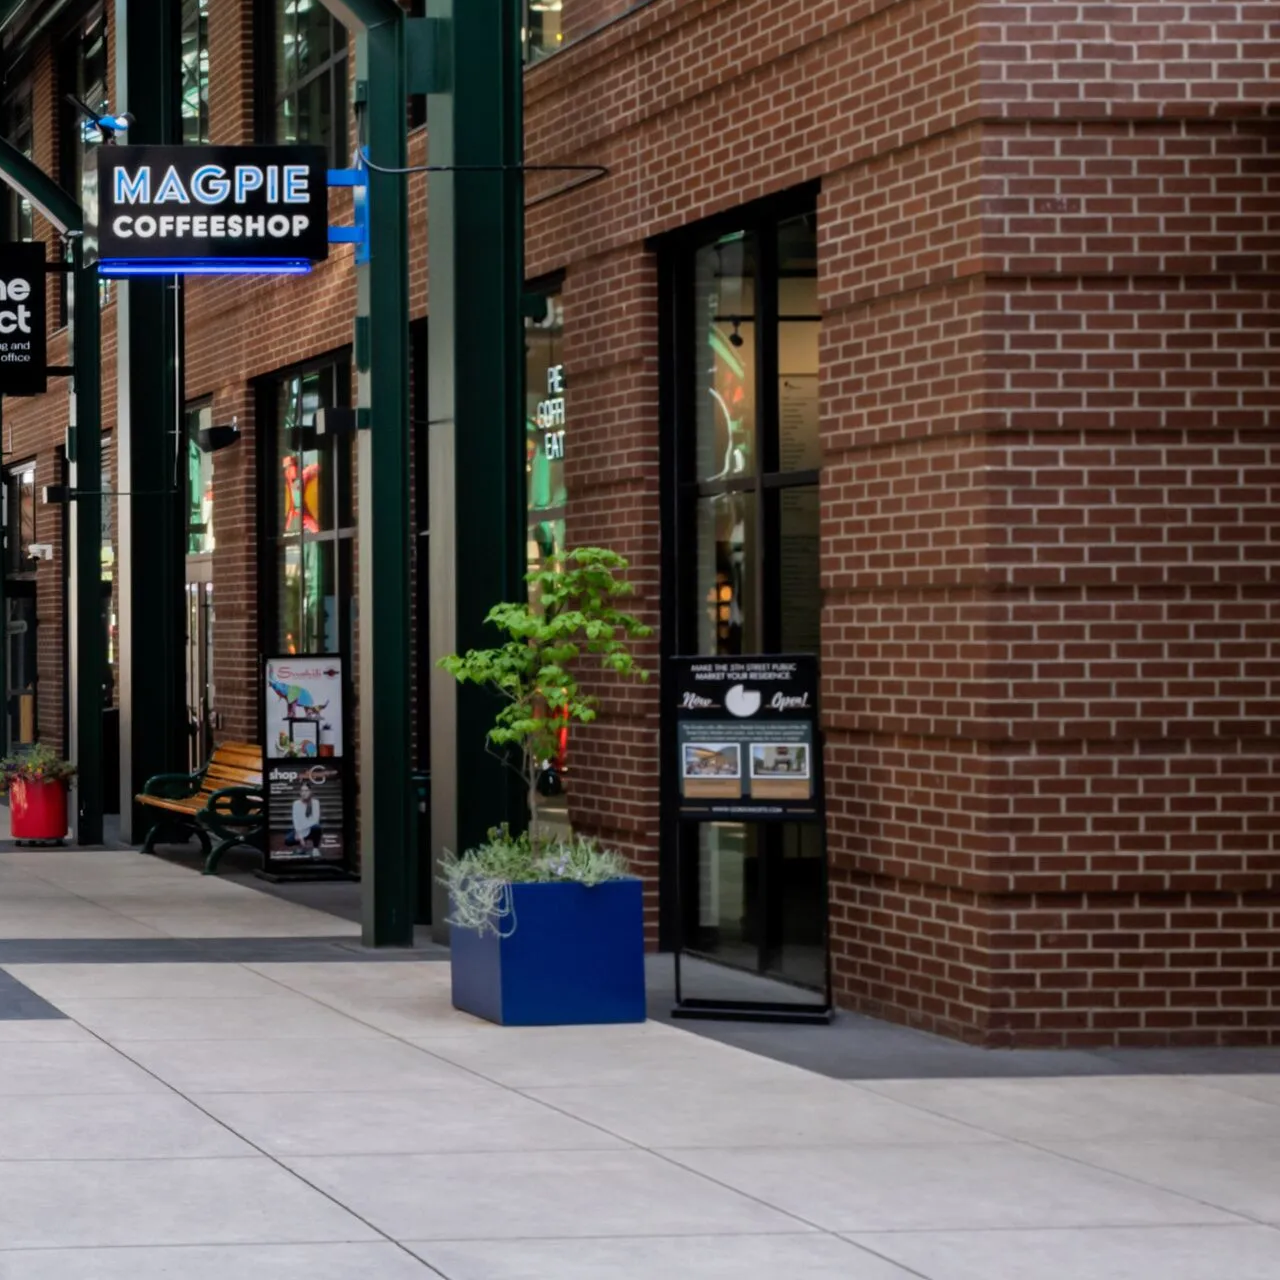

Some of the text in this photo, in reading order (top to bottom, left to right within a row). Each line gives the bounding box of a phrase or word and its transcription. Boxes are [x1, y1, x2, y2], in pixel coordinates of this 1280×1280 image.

[112, 164, 311, 205] MAGPIE
[112, 214, 310, 239] COFFEESHOP
[10, 340, 31, 351] and
[0, 352, 31, 362] office
[690, 664, 713, 672] MAKE
[714, 663, 728, 672] THE
[745, 663, 771, 672] STREET
[695, 672, 725, 681] MARKET
[726, 672, 748, 680] YOUR
[683, 691, 809, 712] Now Open!
[269, 768, 298, 783] shop
